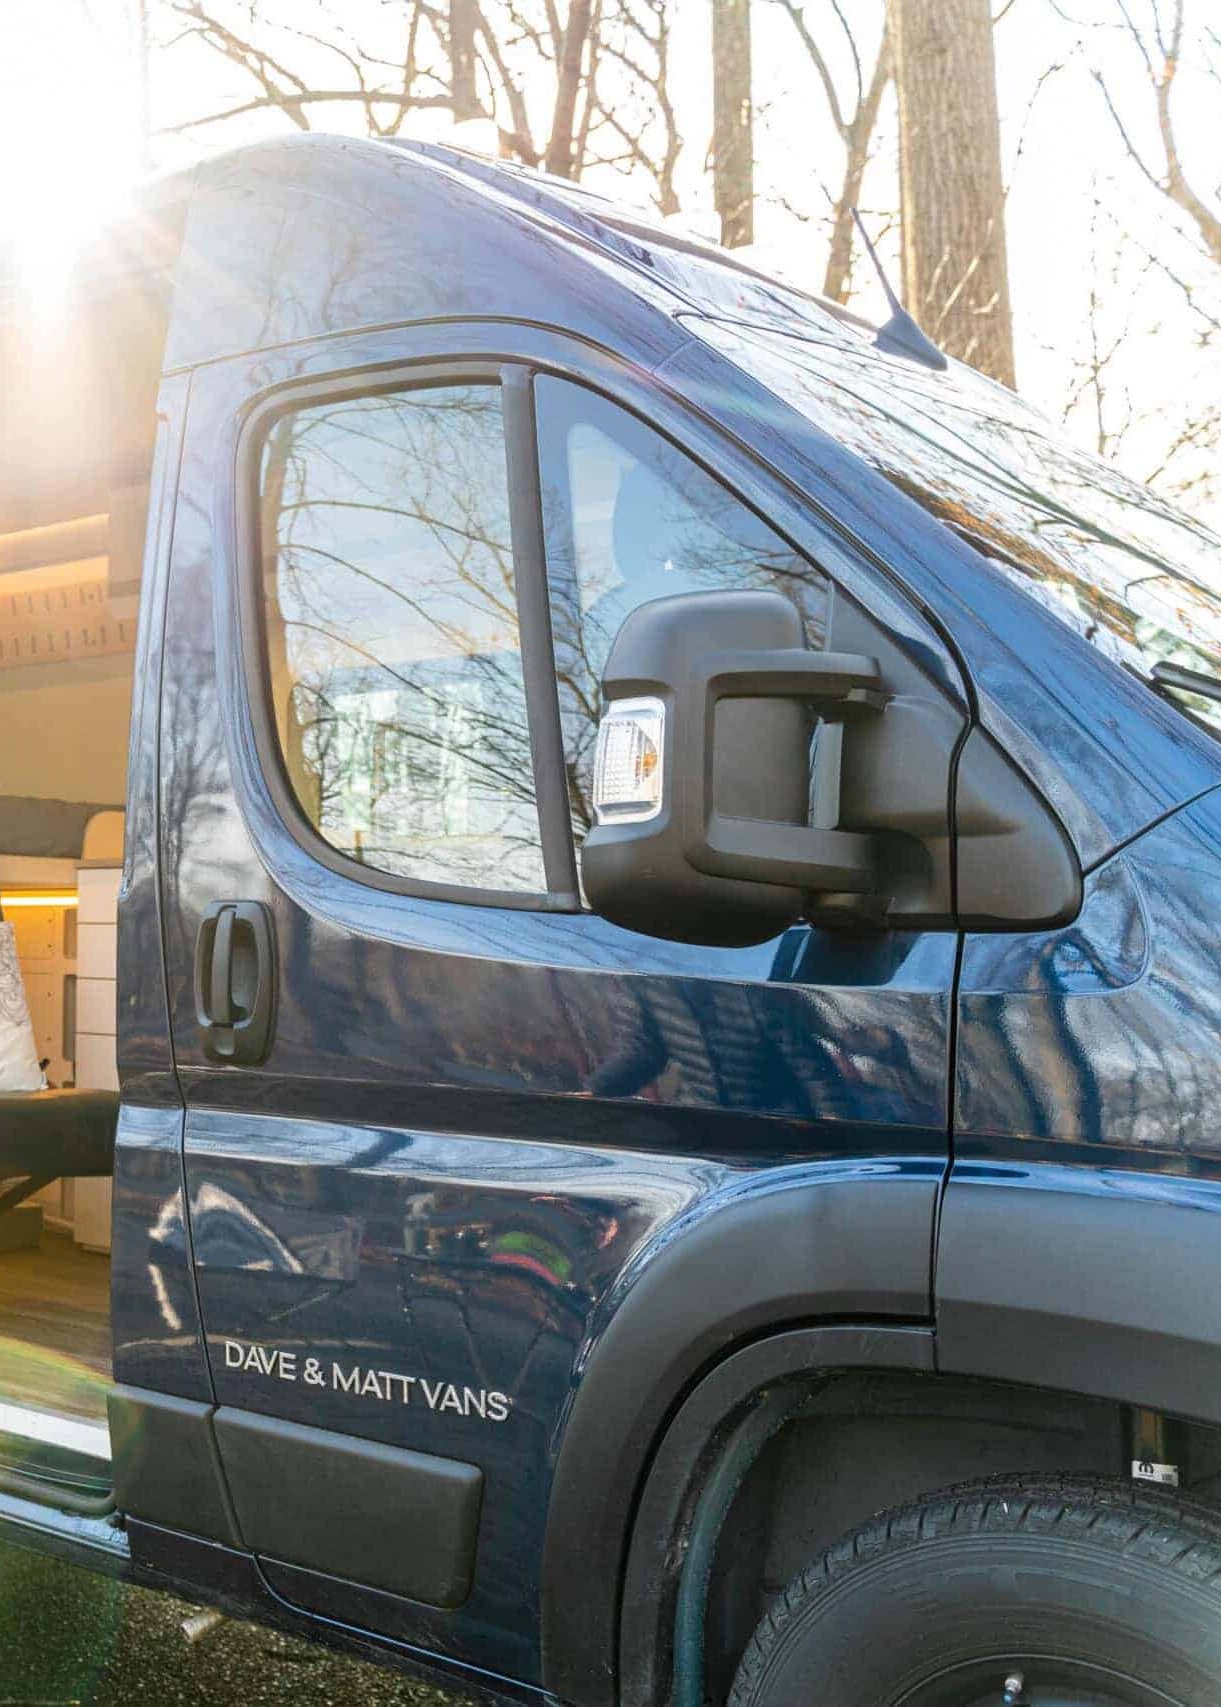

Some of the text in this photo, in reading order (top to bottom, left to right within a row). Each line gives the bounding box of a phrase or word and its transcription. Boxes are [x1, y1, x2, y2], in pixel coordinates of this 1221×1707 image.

[225, 1340, 509, 1421] DAVE & MATT VANS
